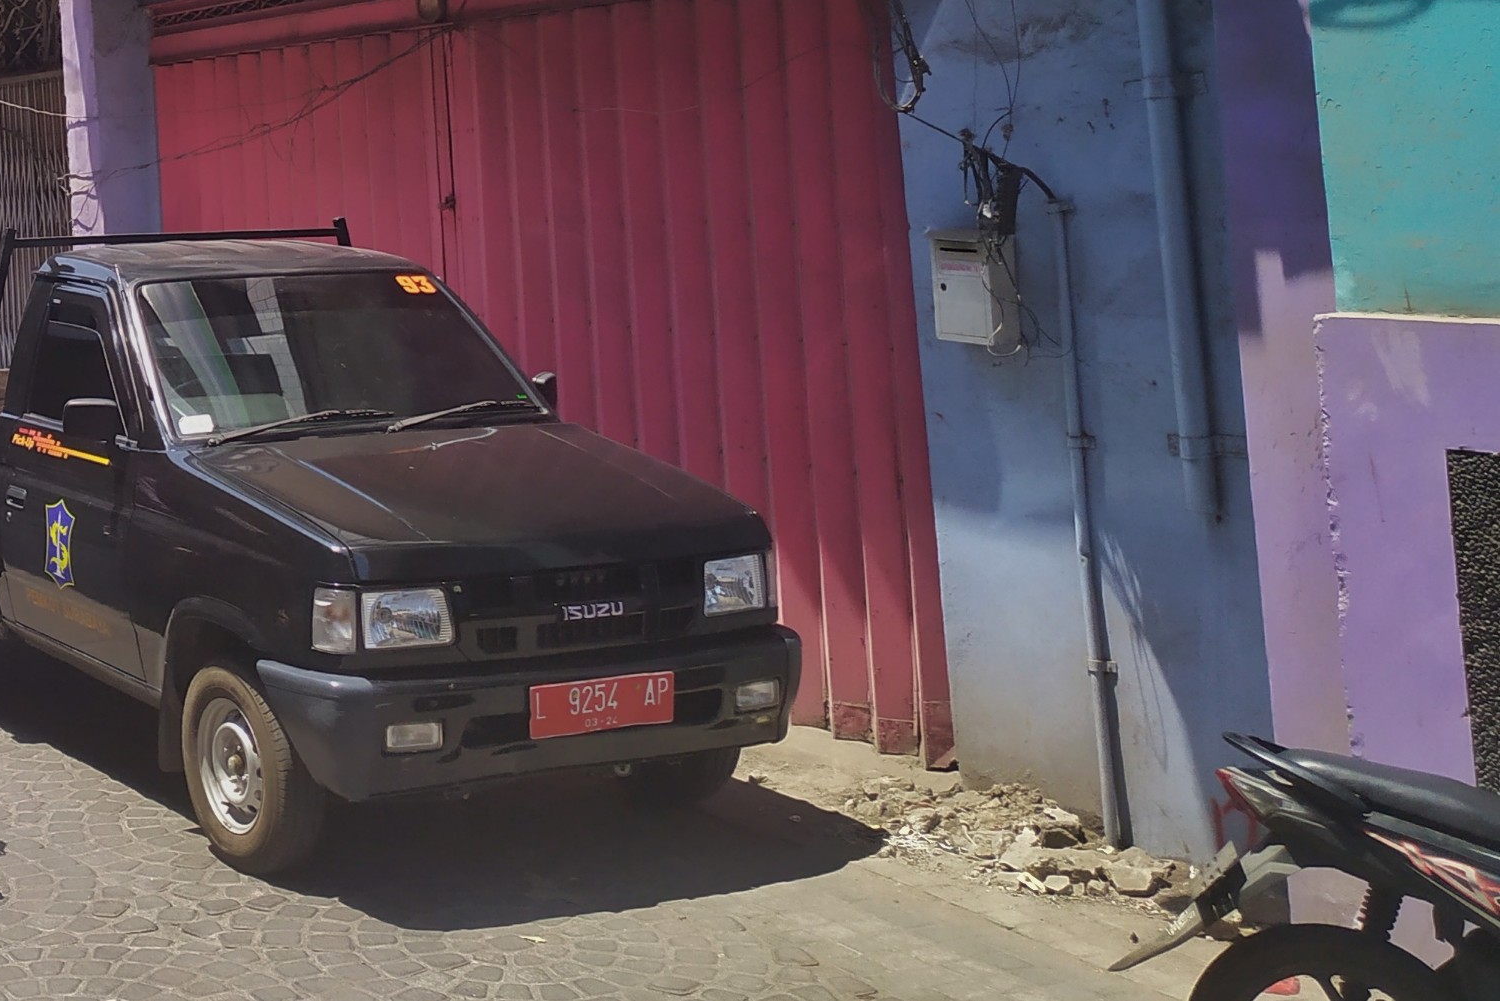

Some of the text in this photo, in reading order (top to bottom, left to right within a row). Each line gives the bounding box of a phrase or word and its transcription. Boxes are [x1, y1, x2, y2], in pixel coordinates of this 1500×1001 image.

[394, 275, 437, 294] 93
[11, 433, 35, 450] Pick-Up
[561, 601, 624, 621] ISUZU
[535, 677, 669, 720] L 9254 AP
